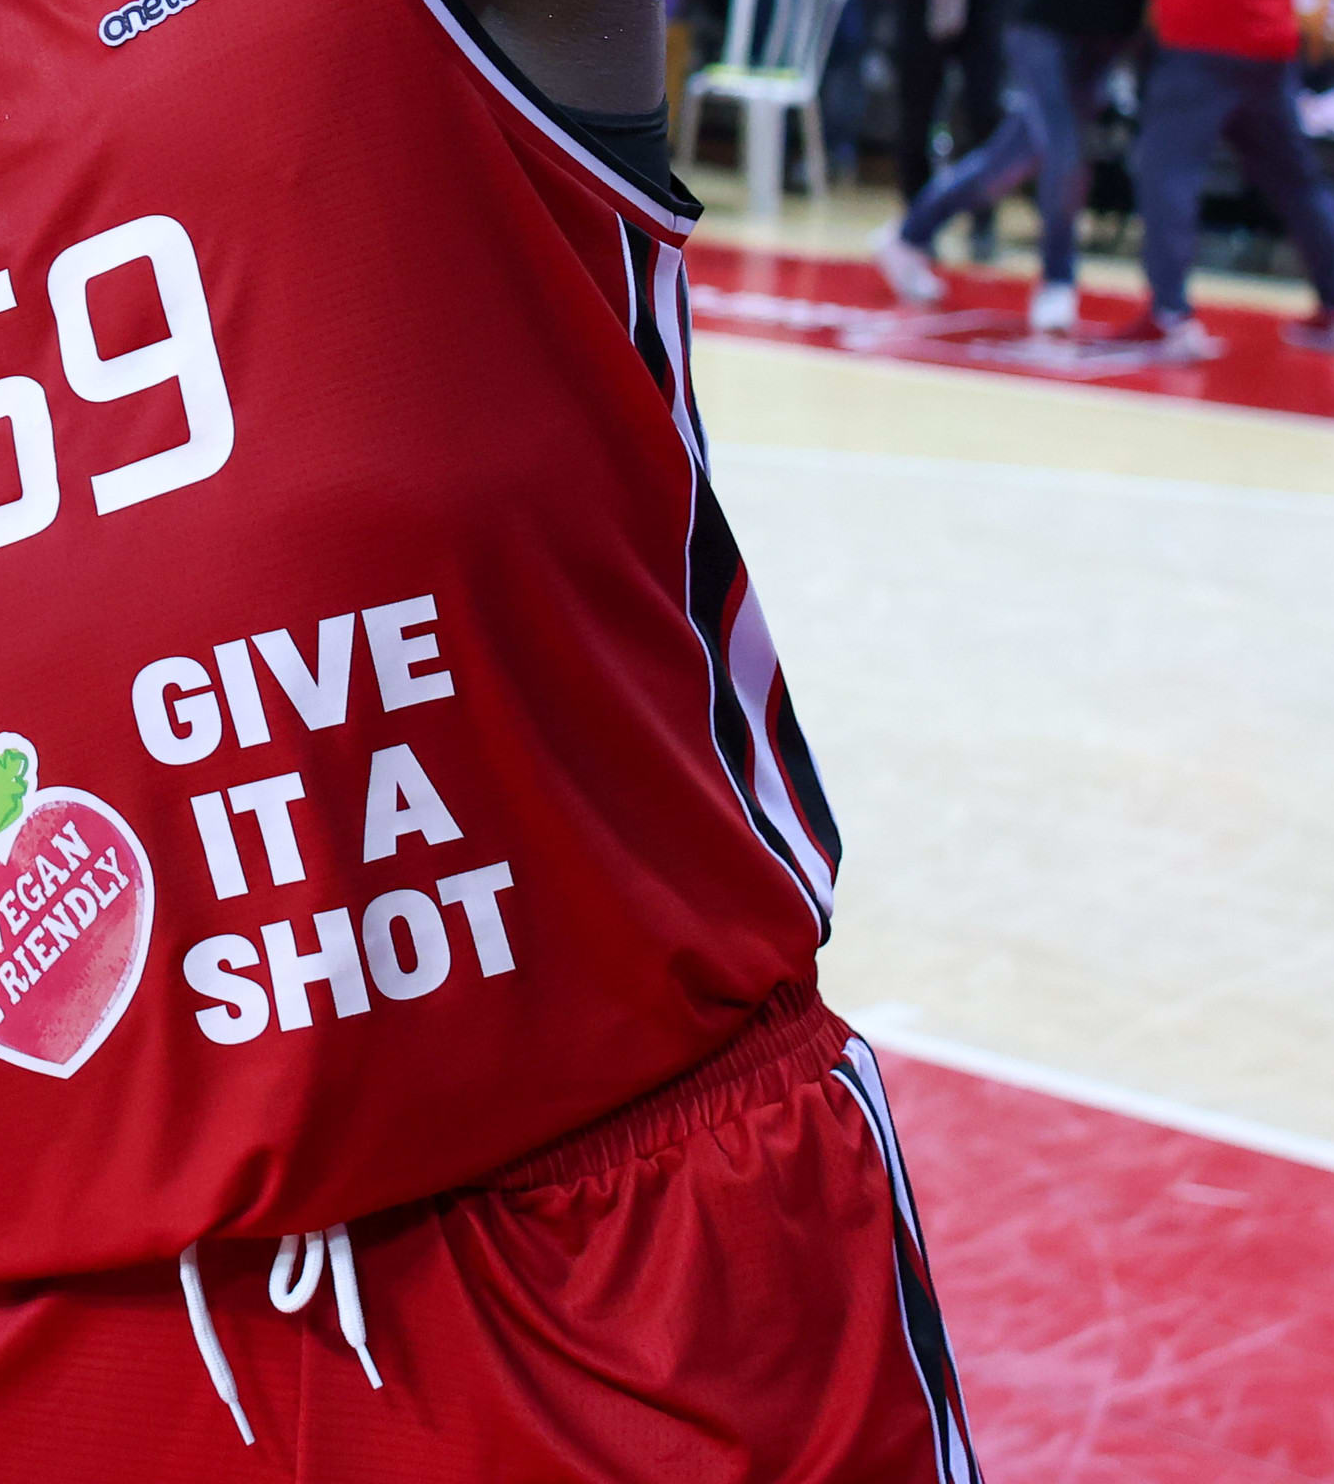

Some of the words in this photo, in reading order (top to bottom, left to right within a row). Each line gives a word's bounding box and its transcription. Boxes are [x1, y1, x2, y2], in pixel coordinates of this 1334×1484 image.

[131, 593, 456, 766] GIVE
[190, 771, 308, 901] IT
[362, 743, 465, 865] A
[182, 860, 517, 1047] SHOT
